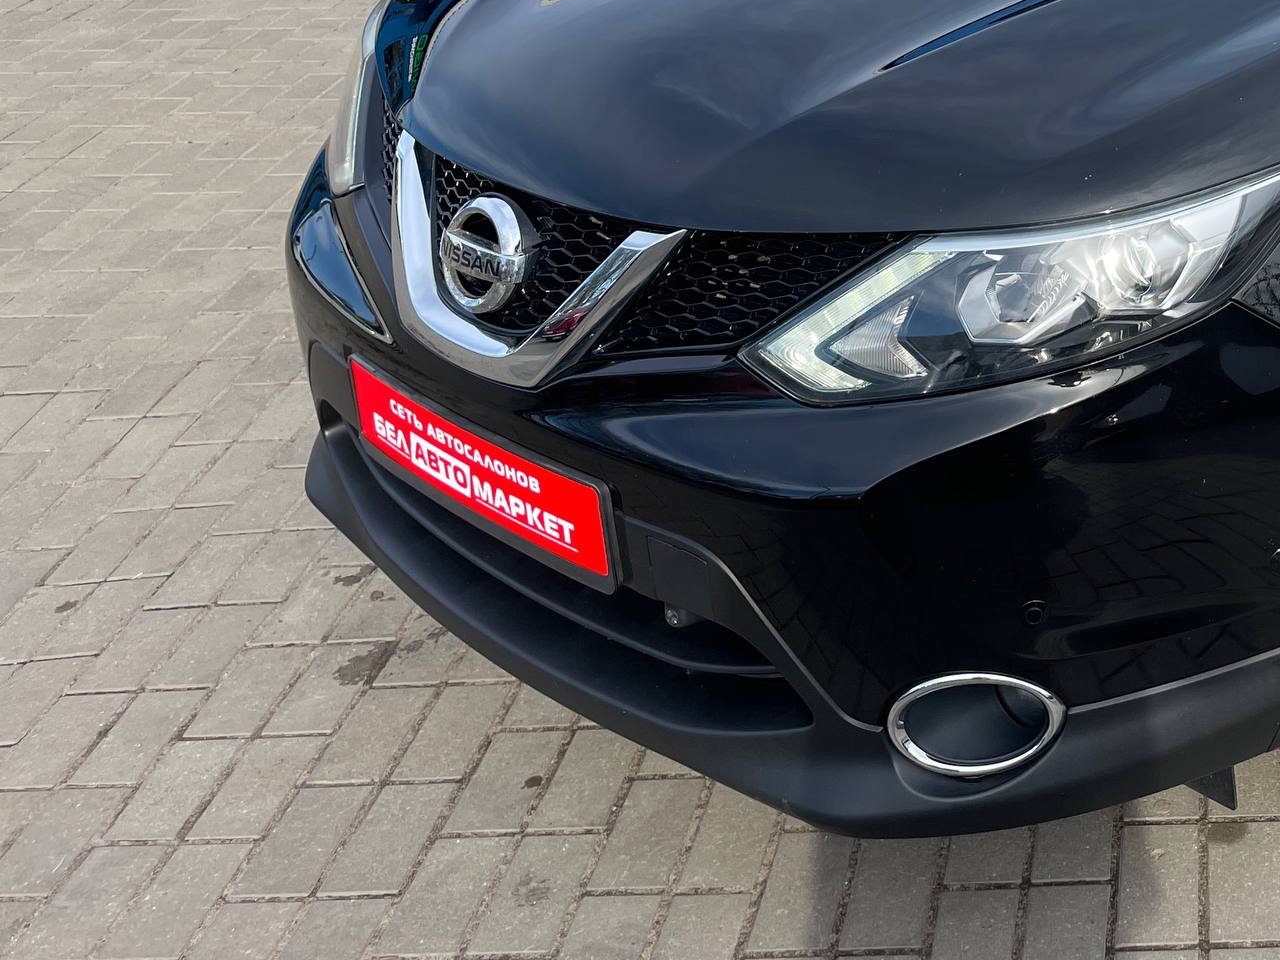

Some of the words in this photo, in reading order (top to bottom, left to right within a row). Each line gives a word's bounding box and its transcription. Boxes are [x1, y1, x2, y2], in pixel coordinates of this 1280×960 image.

[373, 411, 411, 455] БЕЛ
[414, 438, 468, 486] АВТО
[471, 474, 574, 544] МАРКЕТ
[389, 399, 423, 431] СЕТЬ
[426, 424, 541, 493] АВТОСАЛОНОВ
